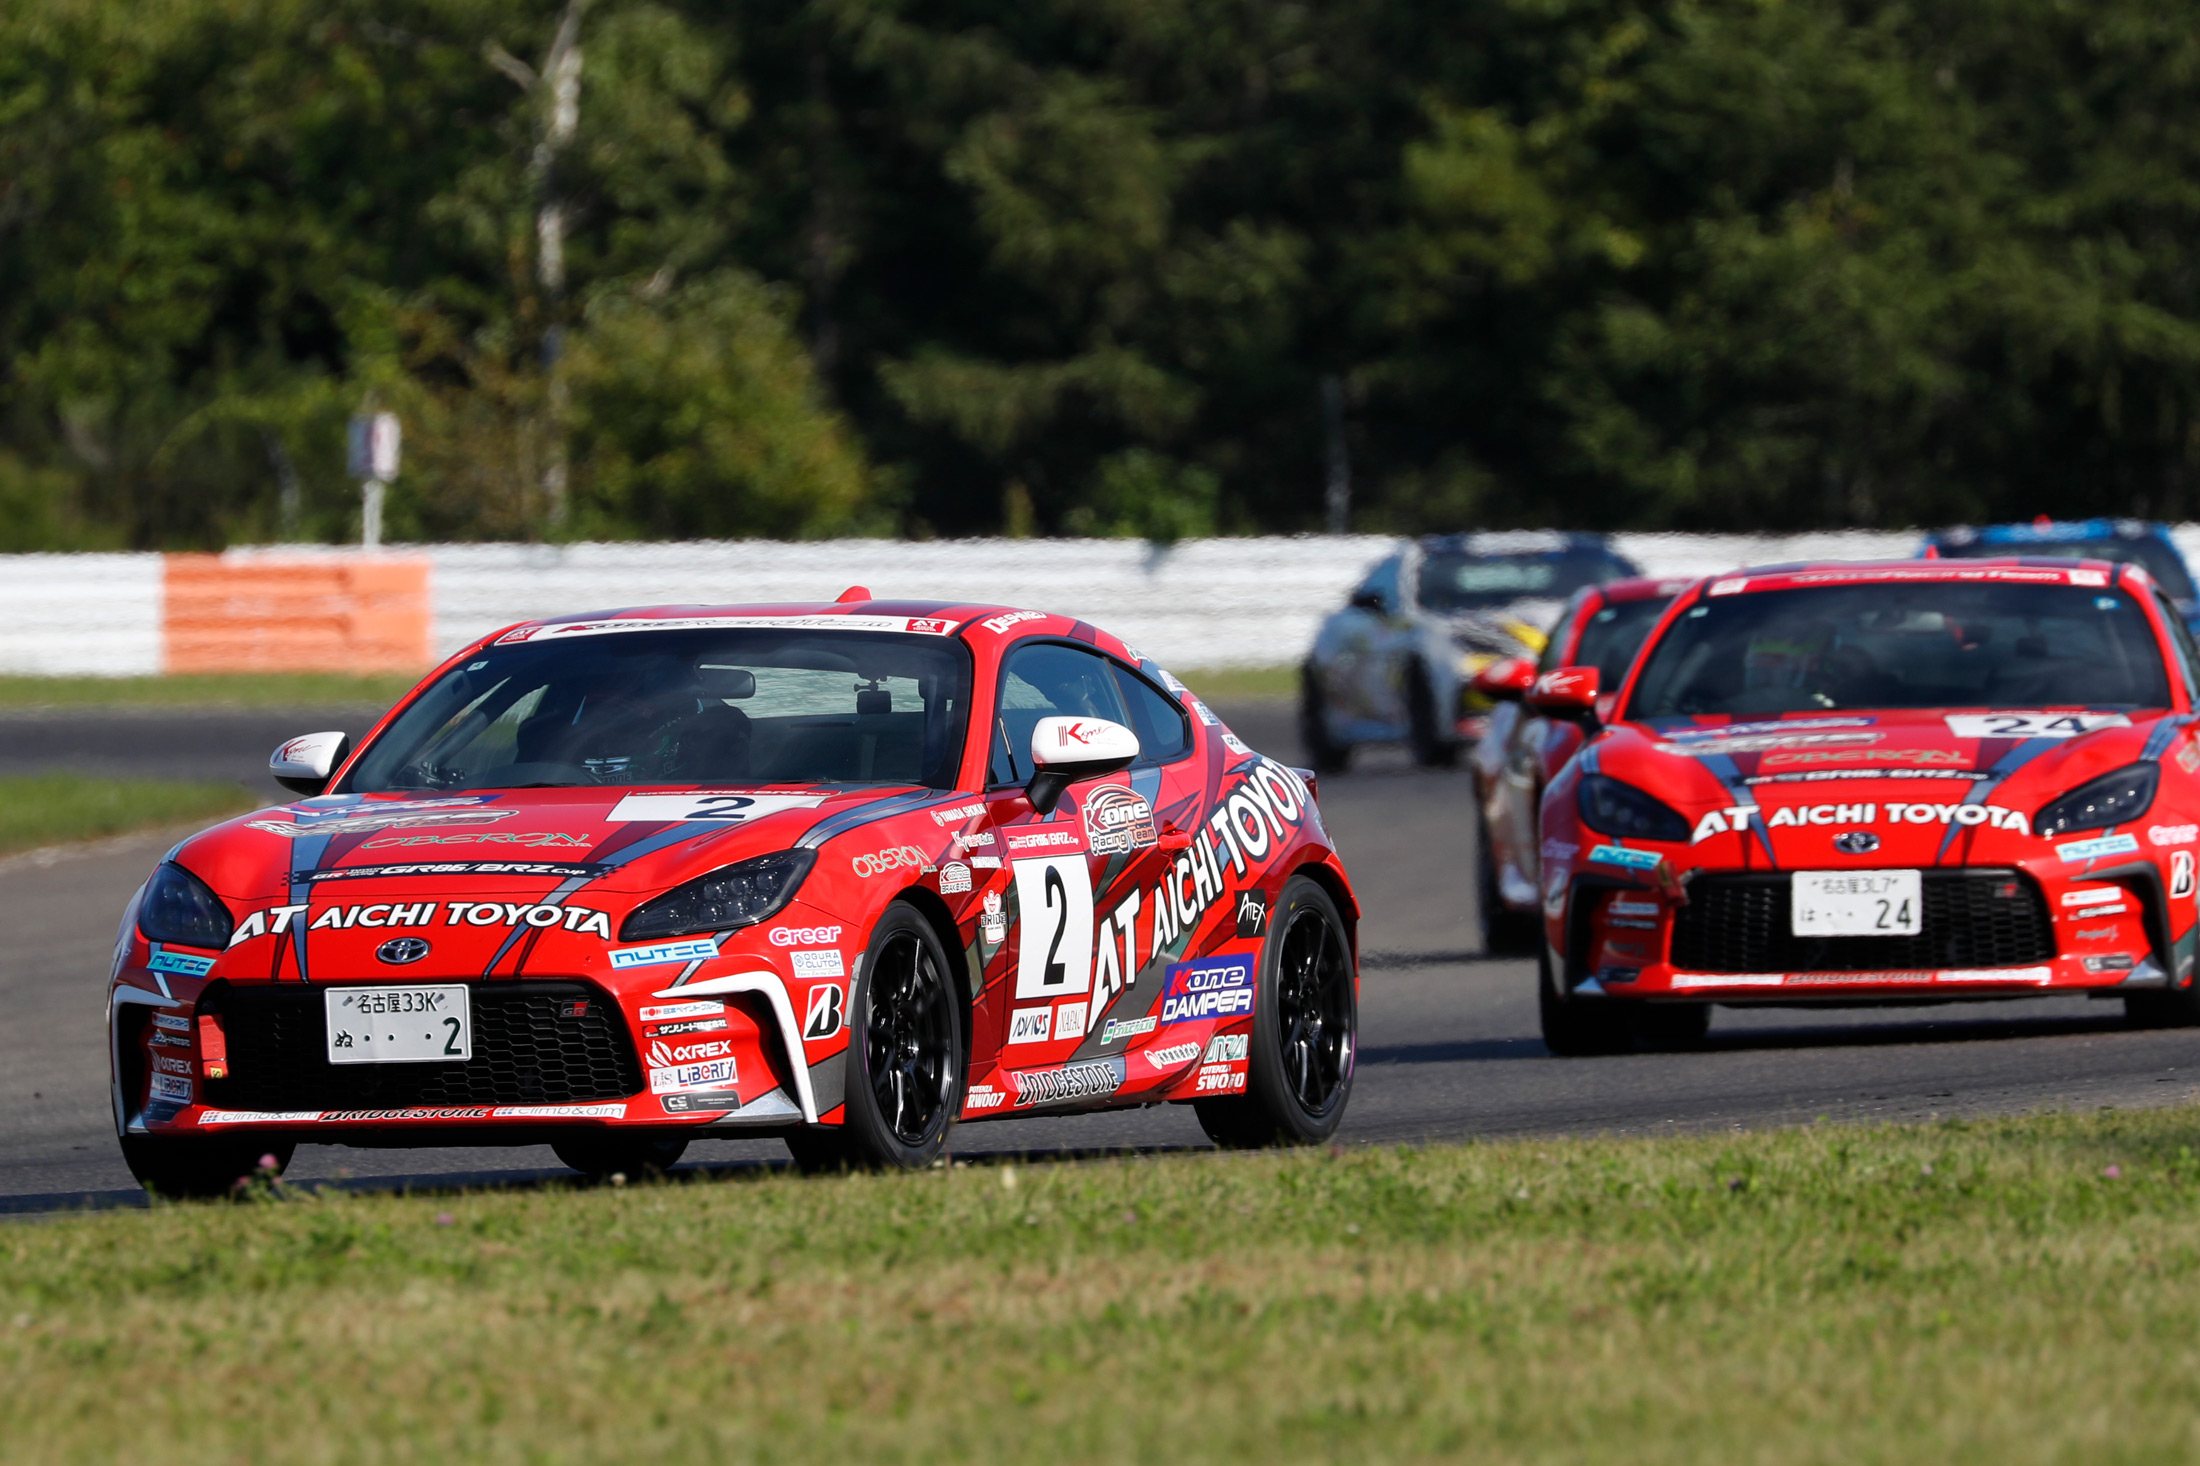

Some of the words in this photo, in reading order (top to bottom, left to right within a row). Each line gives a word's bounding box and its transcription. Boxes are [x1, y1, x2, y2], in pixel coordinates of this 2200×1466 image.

[1982, 715, 2088, 736] 24
[684, 797, 756, 819] 2
[1690, 805, 1761, 846] AT
[1768, 803, 1876, 828] AICHI
[1885, 803, 2030, 835] TOYOTA
[362, 832, 590, 848] OBERON
[1092, 831, 1128, 848] Racing
[1129, 827, 1156, 842] Team
[852, 845, 932, 878] OBERON
[228, 904, 311, 949] AT
[310, 902, 437, 930] AICHI
[447, 902, 612, 940] TOYOTA
[981, 912, 1006, 927] BRIDE
[1044, 864, 1068, 986] 2
[770, 927, 842, 945] Creer
[1088, 888, 1141, 1034] AT
[1152, 827, 1223, 960] AICHI
[151, 955, 211, 973] NUTEC
[615, 943, 712, 964] NUTEC
[804, 952, 839, 960] OGURA
[805, 960, 841, 968] CLUTCH
[357, 991, 438, 1014] 名古屋33K
[1163, 988, 1253, 1022] DAMPER
[334, 1029, 354, 1048] ぬ
[969, 1084, 993, 1094] POTENZA
[1013, 1061, 1121, 1107] BRIDGESTONE
[966, 1092, 1006, 1108] RW007
